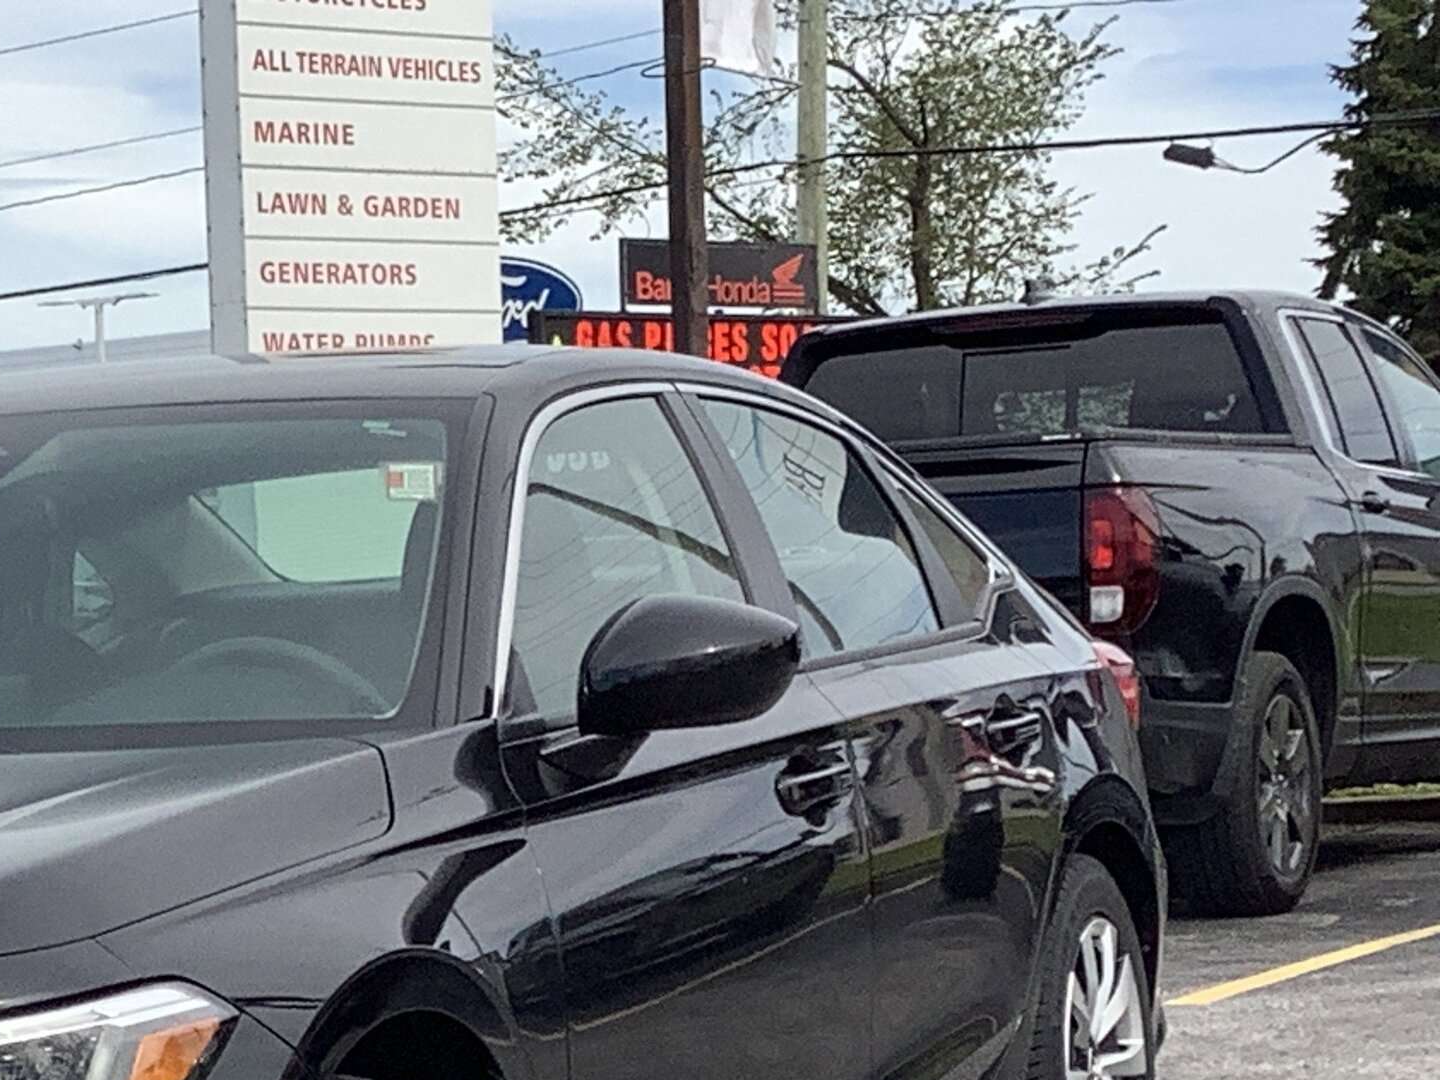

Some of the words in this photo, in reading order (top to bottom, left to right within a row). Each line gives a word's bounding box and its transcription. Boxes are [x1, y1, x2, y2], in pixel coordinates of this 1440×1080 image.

[252, 48, 292, 73] ALL
[295, 51, 382, 78] TERRAIN
[387, 56, 482, 84] VEHICLES
[253, 120, 356, 146] MARINE
[256, 190, 328, 216] LAWN
[336, 194, 354, 217] &
[363, 194, 461, 220] GARDEN
[260, 261, 418, 286] GENERATORS
[262, 332, 346, 351] WATER
[576, 319, 633, 348] GAS
